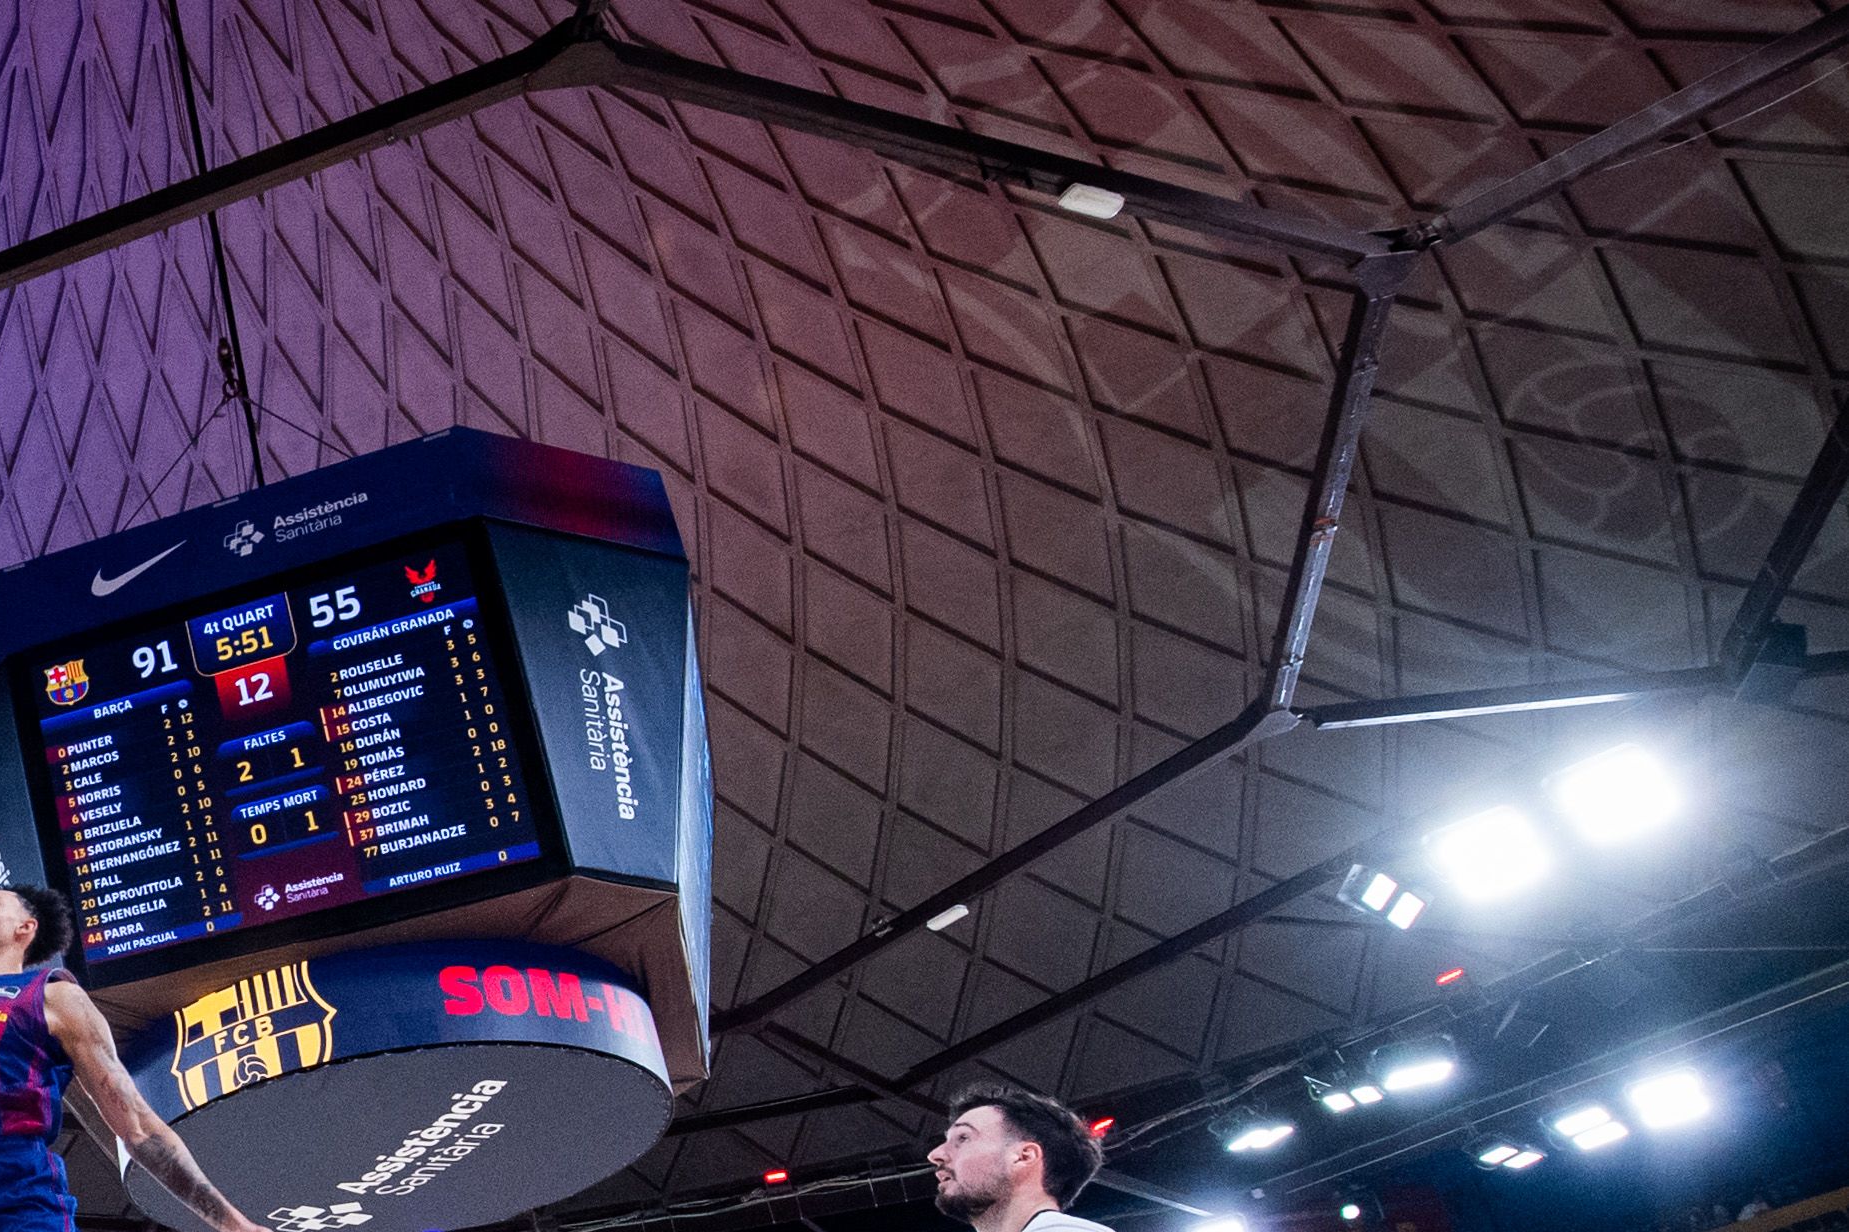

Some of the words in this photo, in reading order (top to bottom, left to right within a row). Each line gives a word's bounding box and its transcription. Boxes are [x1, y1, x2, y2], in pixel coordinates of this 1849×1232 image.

[272, 490, 368, 529] Assistència
[275, 510, 344, 544] Sanitària
[204, 621, 220, 634] 4t
[222, 604, 273, 631] QUART
[309, 586, 360, 628] 55
[333, 626, 389, 650] COVIRÁN
[386, 608, 454, 636] GRANADA
[132, 640, 178, 678] 91
[216, 626, 273, 660] 5:51
[330, 672, 338, 683] 2
[339, 654, 403, 680] ROUSELLE
[467, 634, 476, 645] 5
[235, 673, 273, 706] 12
[332, 706, 346, 718] 14
[348, 685, 424, 714] ALIBEGOVIC
[476, 669, 485, 679] 3
[334, 689, 341, 699] 7
[343, 667, 425, 697] OLUMUYIWA
[472, 651, 481, 662] 6
[93, 700, 133, 719] BARÇA
[336, 723, 350, 735] 15
[351, 713, 392, 731] COSTA
[480, 686, 488, 697] 7
[340, 741, 354, 753] 16
[355, 728, 401, 749] DURÁN
[485, 704, 494, 715] 0
[582, 667, 605, 771] Sanitària
[58, 748, 66, 758] 0
[67, 735, 113, 756] PUNTER
[181, 713, 193, 724] 12
[62, 764, 73, 775] 2
[70, 751, 119, 772] MARCOS
[186, 730, 194, 740] 3
[244, 730, 286, 750] FALTES
[344, 758, 358, 771] 19
[359, 746, 405, 766] TOMÀS
[489, 722, 498, 733] 0
[604, 672, 636, 821] Assistència
[65, 781, 73, 791] 3
[74, 772, 102, 789] CALE
[187, 746, 201, 758] 10
[68, 797, 76, 808] 5
[77, 785, 121, 805] NORRIS
[194, 764, 202, 774] 6
[237, 761, 253, 782] 2
[291, 748, 305, 768] 1
[346, 776, 362, 789] 24
[364, 765, 405, 784] PÉREZ
[491, 739, 506, 752] 18
[351, 793, 366, 806] 25
[368, 778, 426, 801] HOWARD
[498, 757, 507, 768] 2
[72, 813, 81, 824] 6
[80, 802, 122, 822] VESELY
[197, 780, 205, 791] 5
[74, 831, 82, 841] 8
[84, 816, 142, 839] BRIZUELA
[198, 797, 212, 809] 10
[240, 800, 281, 818] TEMPS
[283, 790, 317, 808] MORT
[354, 810, 370, 823] 29
[372, 800, 411, 819] BOZIC
[503, 775, 511, 786] 3
[359, 828, 374, 841] 37
[376, 814, 429, 837] BRIMAH
[507, 793, 516, 803] 4
[73, 848, 86, 860] 13
[87, 828, 162, 856] SATORANSKY
[205, 815, 213, 826] 2
[251, 824, 267, 844] 0
[305, 811, 319, 831] 1
[363, 846, 378, 858] 77
[380, 824, 466, 854] BURJANADZE
[511, 811, 519, 822] 7
[76, 864, 89, 876] 14
[90, 840, 181, 872] HERNANGÓMEZ
[206, 831, 218, 843] 11
[80, 881, 92, 893] 19
[94, 874, 122, 889] FALL
[210, 848, 222, 860] 11
[389, 870, 429, 887] ARTURO
[426, 862, 461, 878] RUIZ
[81, 897, 100, 910] 20
[97, 876, 183, 906] LAPROVITTOLA
[216, 866, 224, 876] 6
[85, 915, 99, 927] 23
[100, 898, 167, 923] SHENGELIA
[219, 883, 227, 893] 4
[285, 872, 344, 896] Assistência
[285, 882, 329, 903] Sanitària
[88, 932, 106, 943] 44
[104, 922, 144, 940] PARRA
[221, 900, 233, 912] 11
[107, 940, 135, 955] XAVI
[132, 931, 178, 949] PASCUAL
[214, 1014, 275, 1055] FCB
[338, 1078, 508, 1195] Assistència
[376, 1120, 505, 1197] Sanitària
